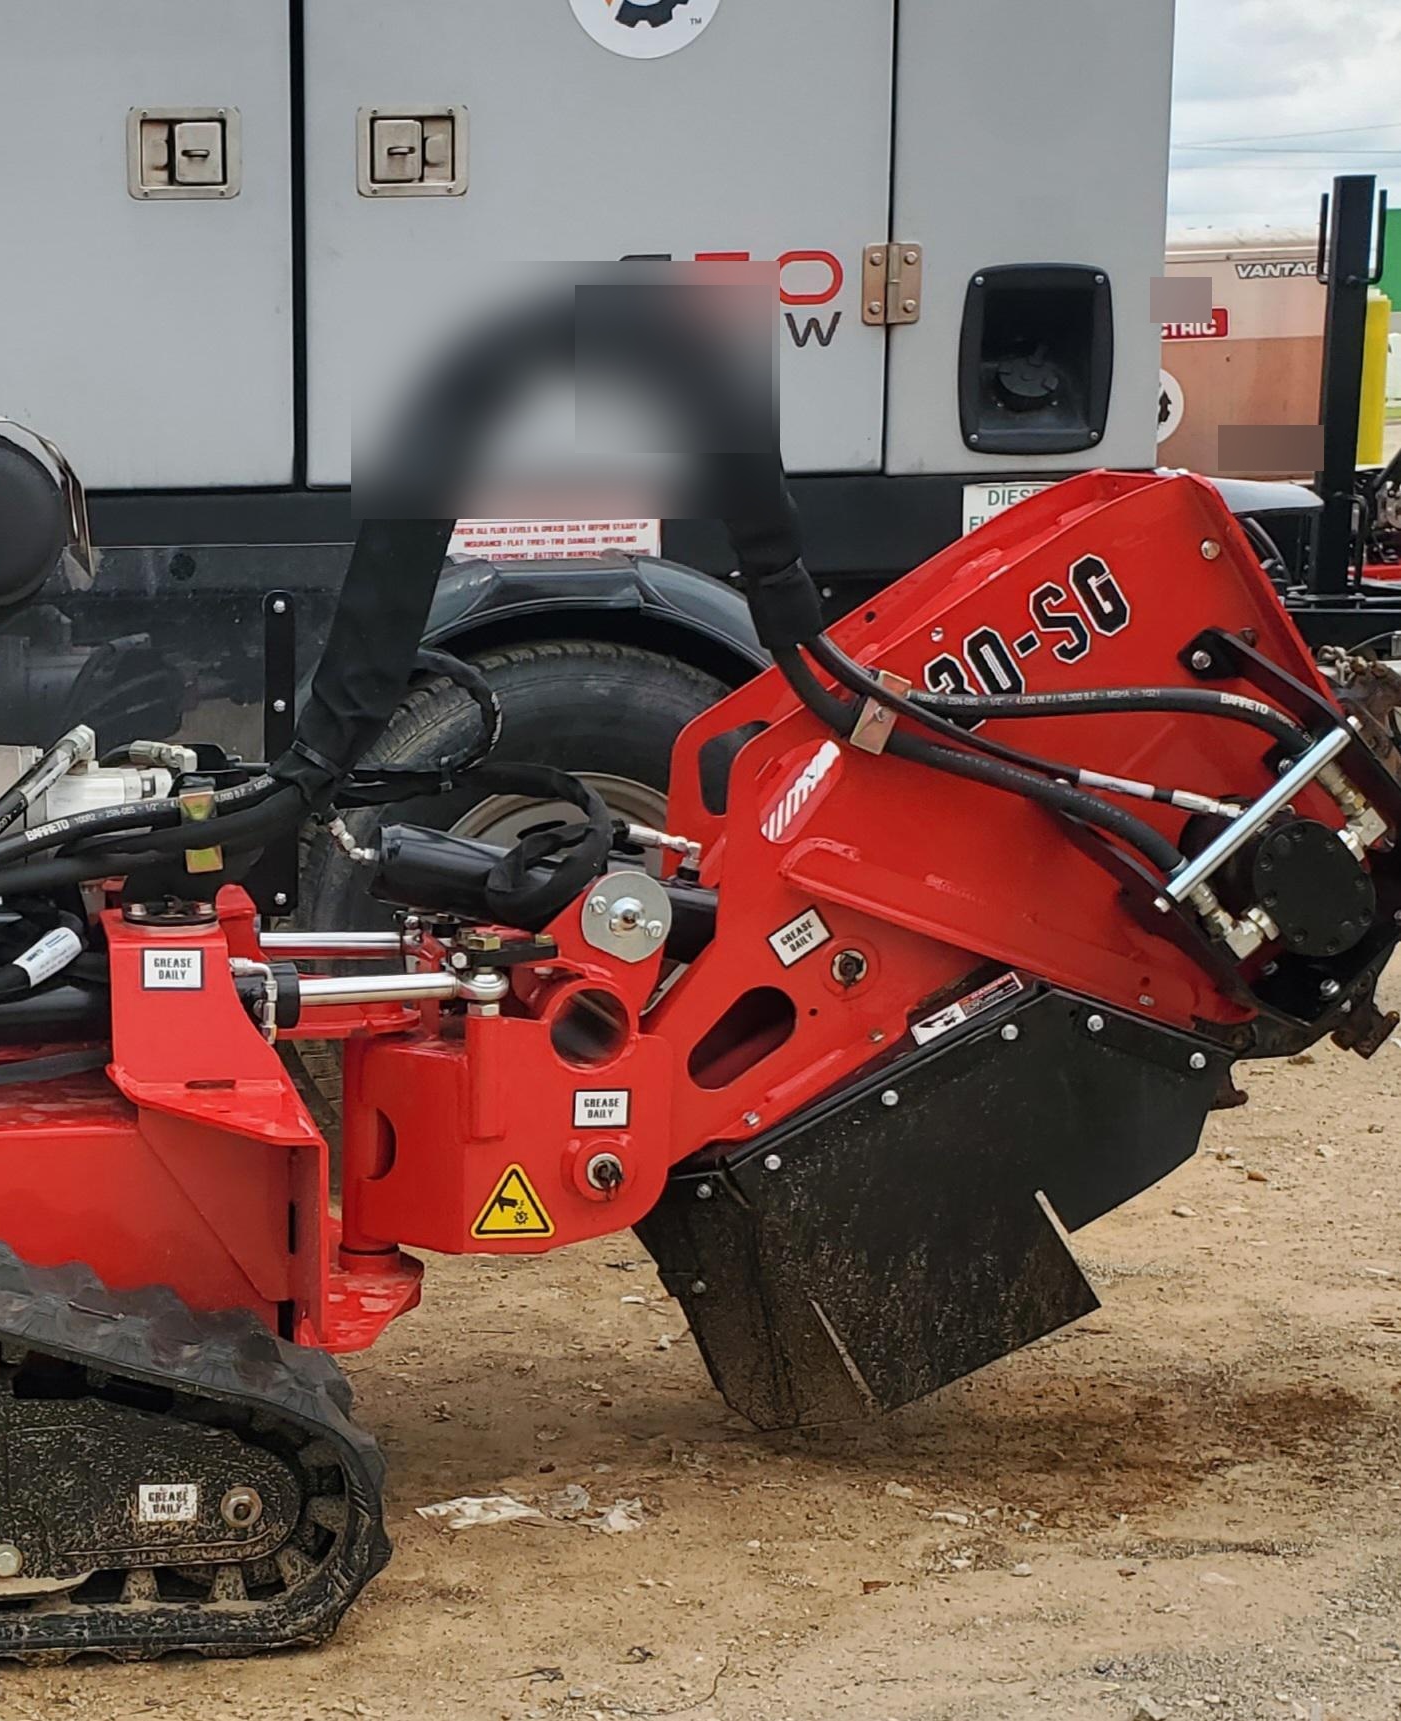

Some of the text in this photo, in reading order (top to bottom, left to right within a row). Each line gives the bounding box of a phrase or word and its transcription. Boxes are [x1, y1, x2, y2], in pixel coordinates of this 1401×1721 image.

[1220, 692, 1269, 715] BARRETO
[24, 818, 70, 842] BARRETO
[780, 918, 814, 946] GREASE
[789, 931, 813, 953] DAILY
[153, 957, 192, 968] GREASE
[158, 969, 186, 980] DAILY
[584, 1097, 620, 1108] GREASE
[587, 1109, 614, 1119] DAILY
